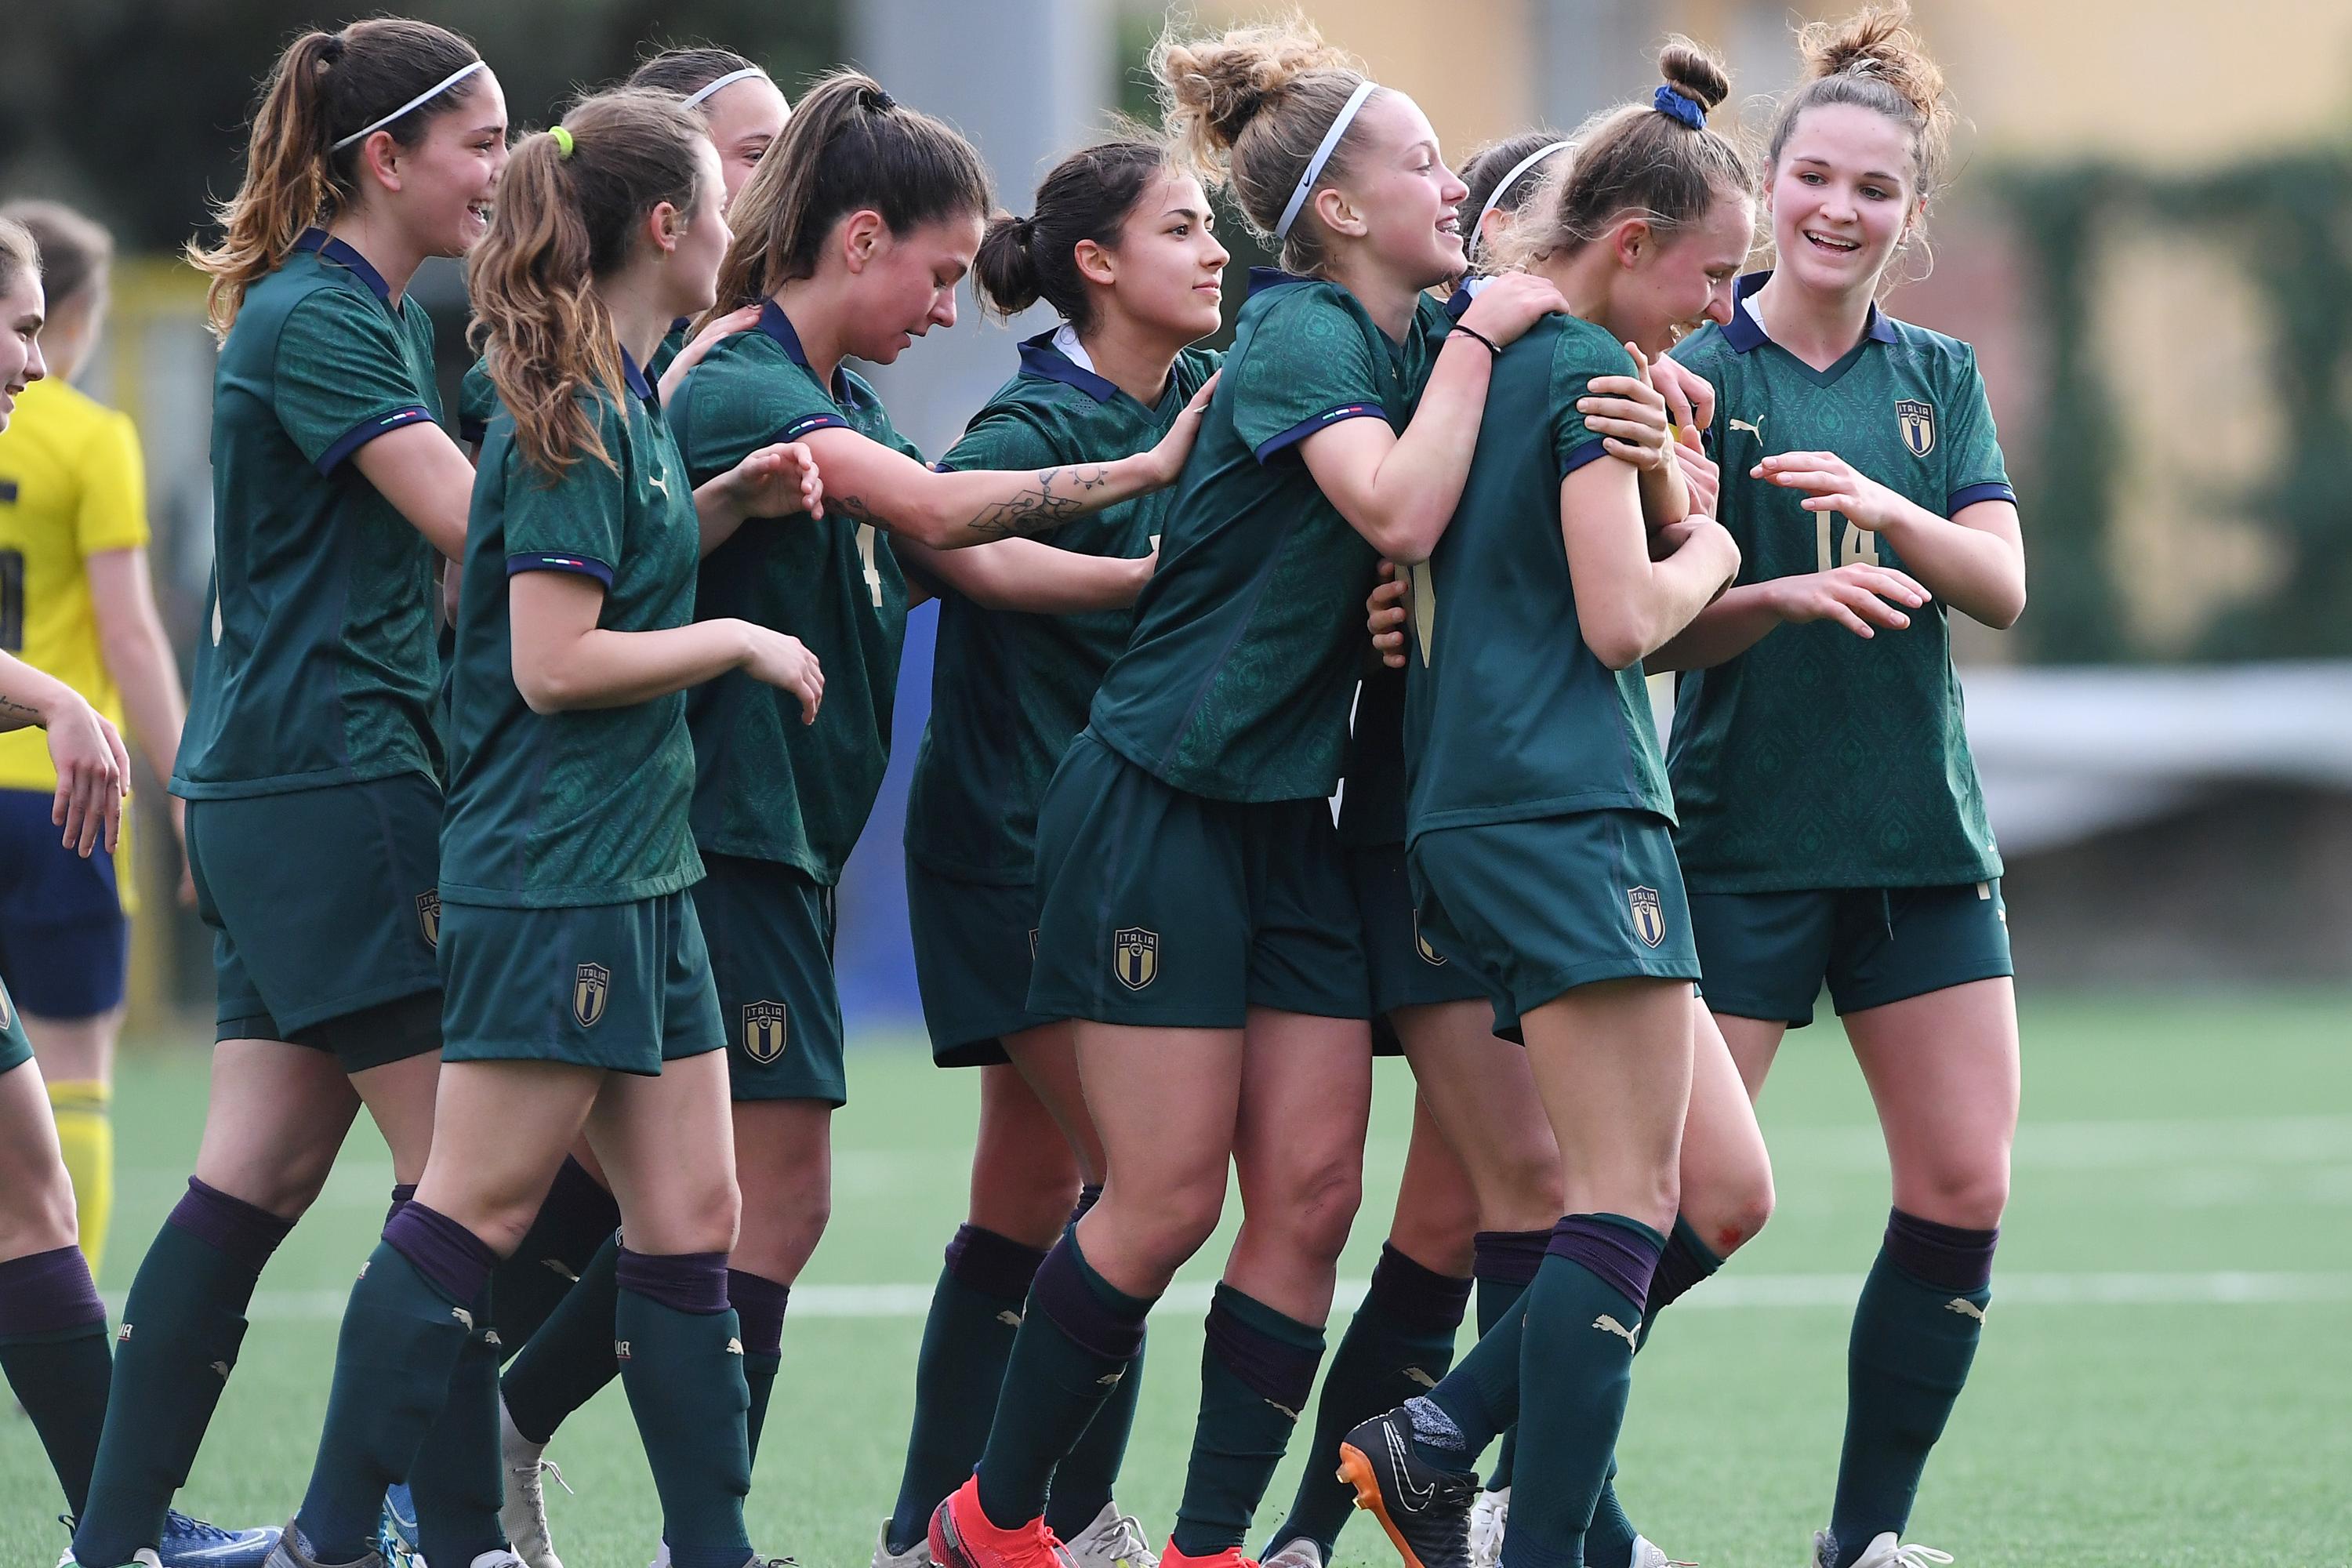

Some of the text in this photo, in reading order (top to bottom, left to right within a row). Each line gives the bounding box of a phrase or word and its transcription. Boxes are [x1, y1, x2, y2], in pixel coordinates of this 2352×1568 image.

[1898, 404, 1929, 415] ITALIA
[1813, 510, 1879, 572] 14
[420, 895, 440, 907] ITAL
[1631, 891, 1656, 902] ITALIA
[1120, 934, 1154, 945] ITALIA
[579, 968, 606, 981] ITALIA
[746, 1007, 782, 1017] ITALIA
